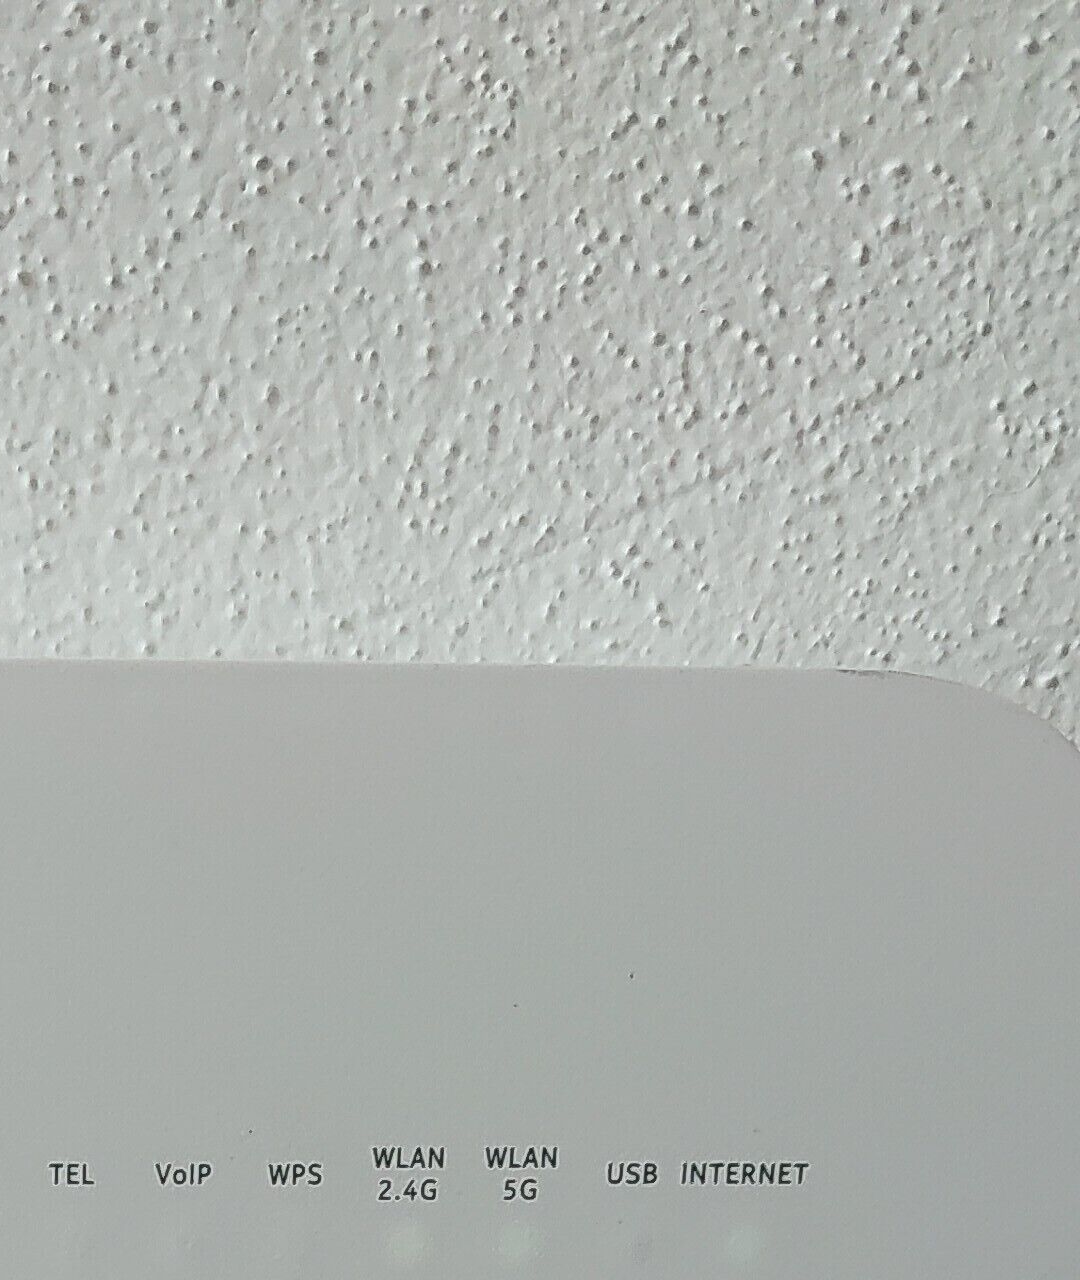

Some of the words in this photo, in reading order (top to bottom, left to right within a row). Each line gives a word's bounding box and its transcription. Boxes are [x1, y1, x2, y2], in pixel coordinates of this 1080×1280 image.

[372, 1145, 445, 1170] WLAN
[485, 1145, 558, 1170] WLAN
[49, 1162, 95, 1187] TEL
[155, 1161, 213, 1186] VoIP
[268, 1162, 323, 1187] WPS
[607, 1161, 658, 1186] USB
[680, 1161, 810, 1186] INTERNET
[377, 1178, 438, 1202] 2.4G
[503, 1178, 540, 1202] 5G
